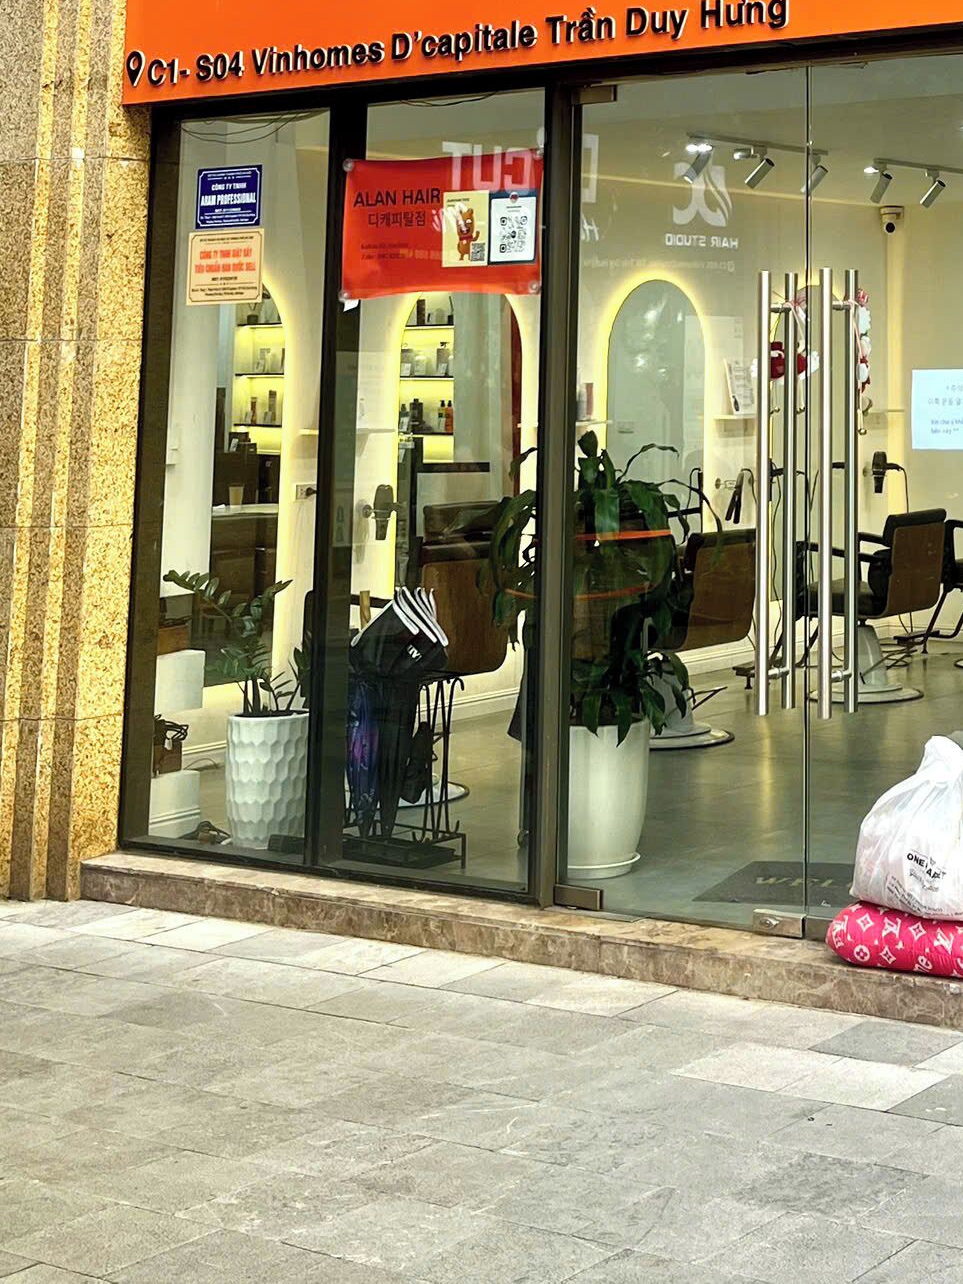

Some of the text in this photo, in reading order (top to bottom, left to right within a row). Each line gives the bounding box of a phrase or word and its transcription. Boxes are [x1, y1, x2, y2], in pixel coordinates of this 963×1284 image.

[148, 57, 190, 86] C1-
[196, 51, 245, 82] S04
[251, 38, 385, 77] Vinhomes
[546, 6, 614, 45] Trần
[626, 6, 687, 45] Duy
[353, 191, 397, 207] ALAN
[402, 188, 441, 204] HAIR
